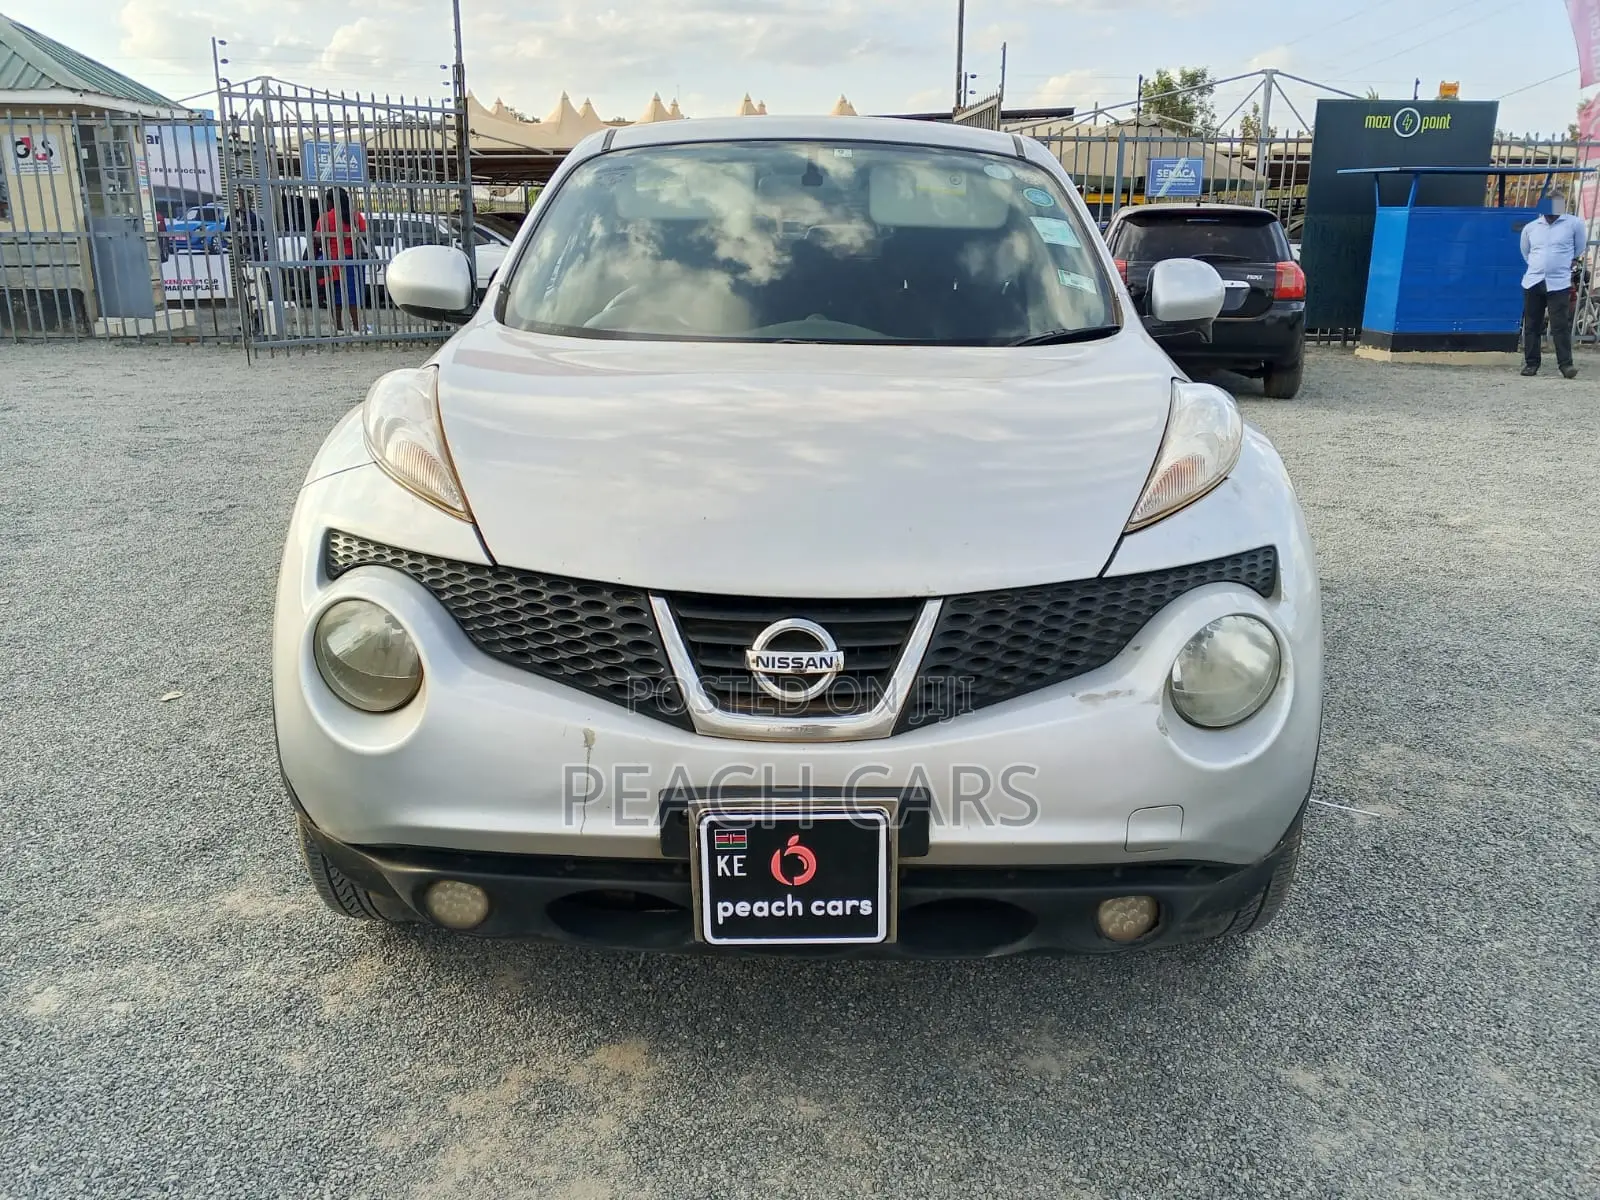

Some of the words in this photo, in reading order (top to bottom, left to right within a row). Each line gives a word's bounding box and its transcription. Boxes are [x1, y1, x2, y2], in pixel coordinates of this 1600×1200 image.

[1421, 113, 1452, 133] point
[755, 656, 834, 669] NISSAN
[716, 855, 748, 877] KE
[717, 893, 803, 925] peach
[810, 899, 873, 916] cars
